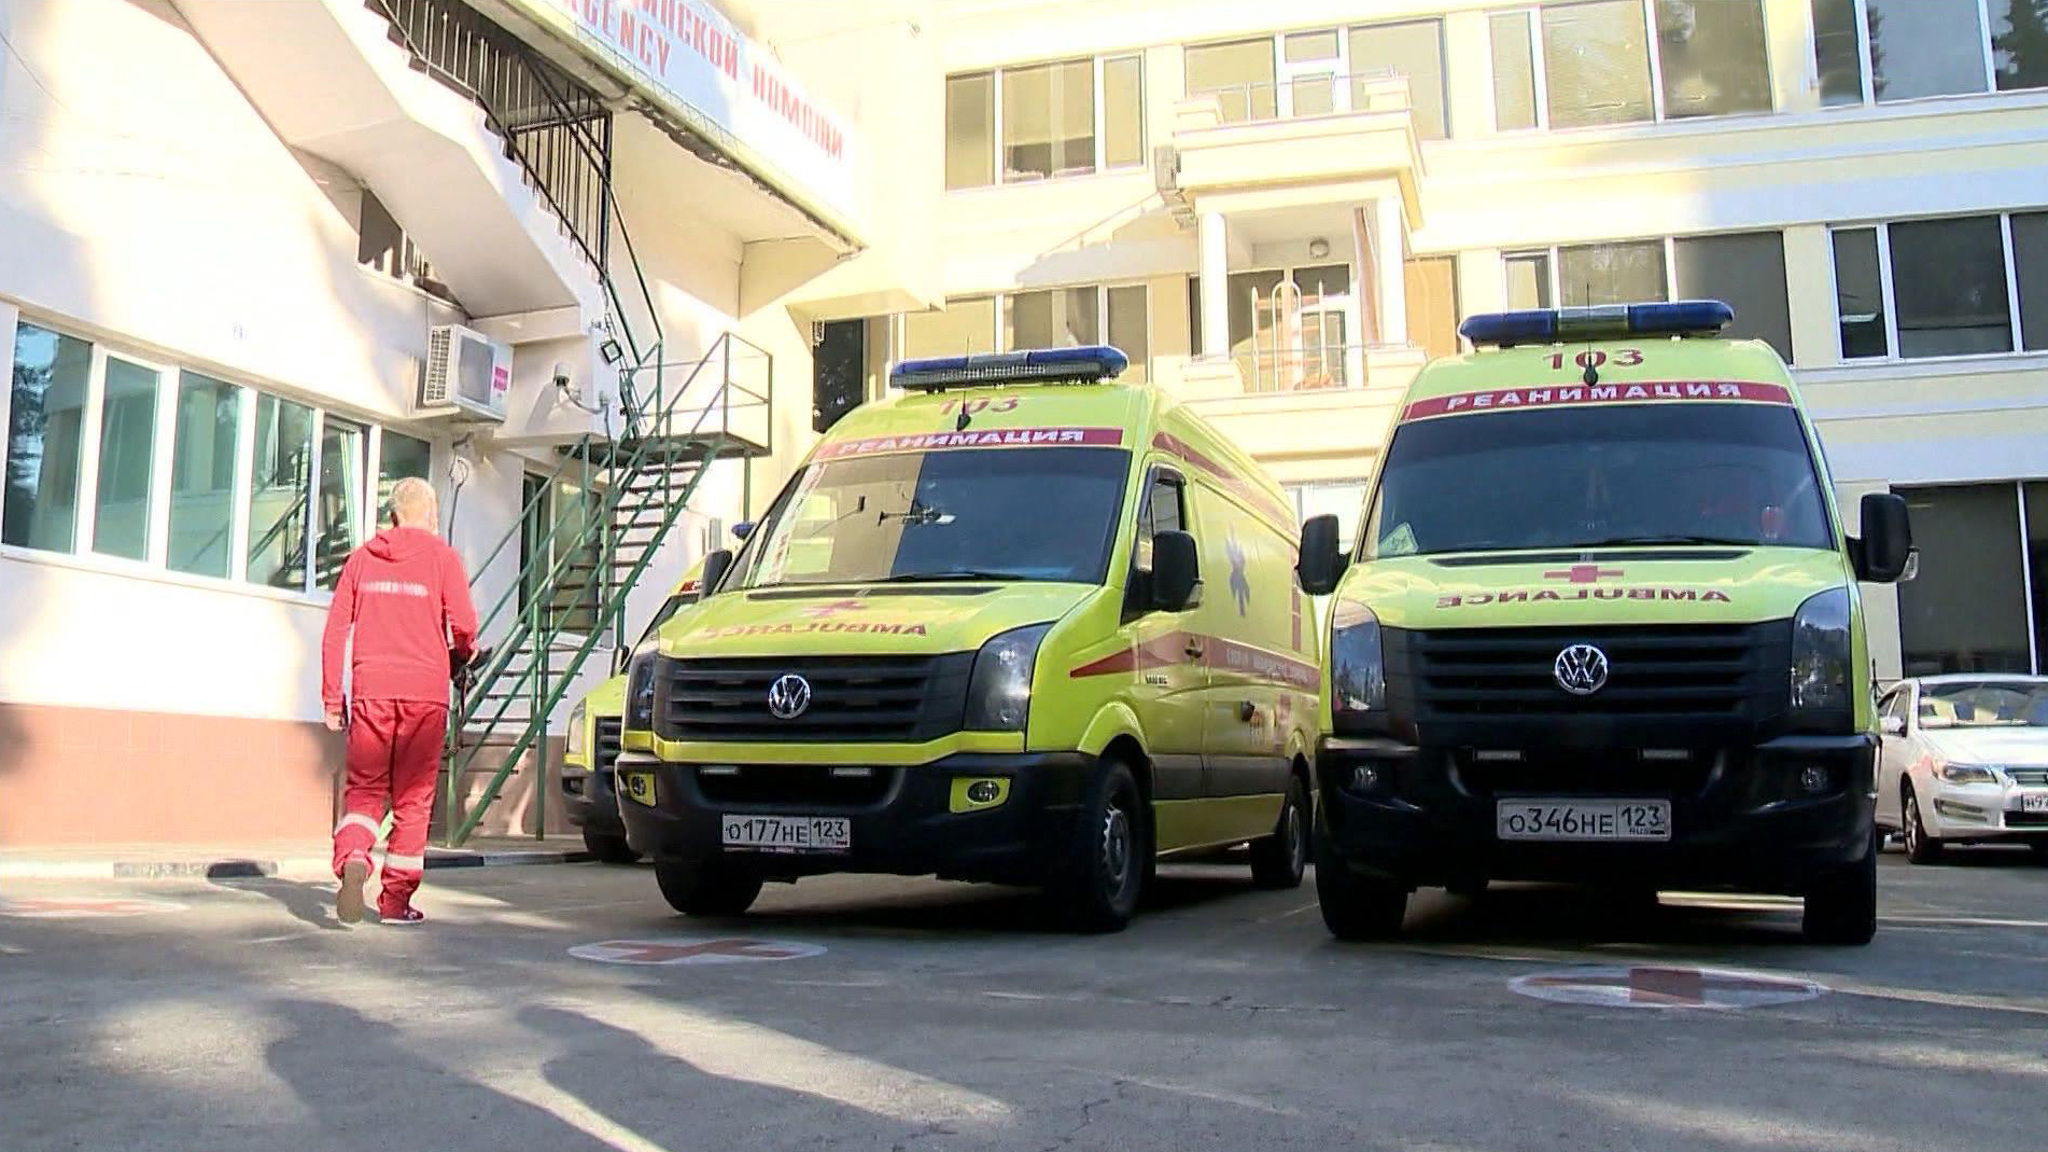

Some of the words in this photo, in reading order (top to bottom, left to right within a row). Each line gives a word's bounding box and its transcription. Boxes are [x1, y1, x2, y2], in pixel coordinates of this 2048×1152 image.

[1543, 349, 1644, 370] 103
[941, 394, 1019, 415] 103
[1447, 383, 1741, 410] РЕАНИМАЦИЯ
[838, 431, 1084, 454] РЕАНИМАЦИЯ
[1621, 806, 1660, 827] 123
[813, 821, 844, 838] 123
